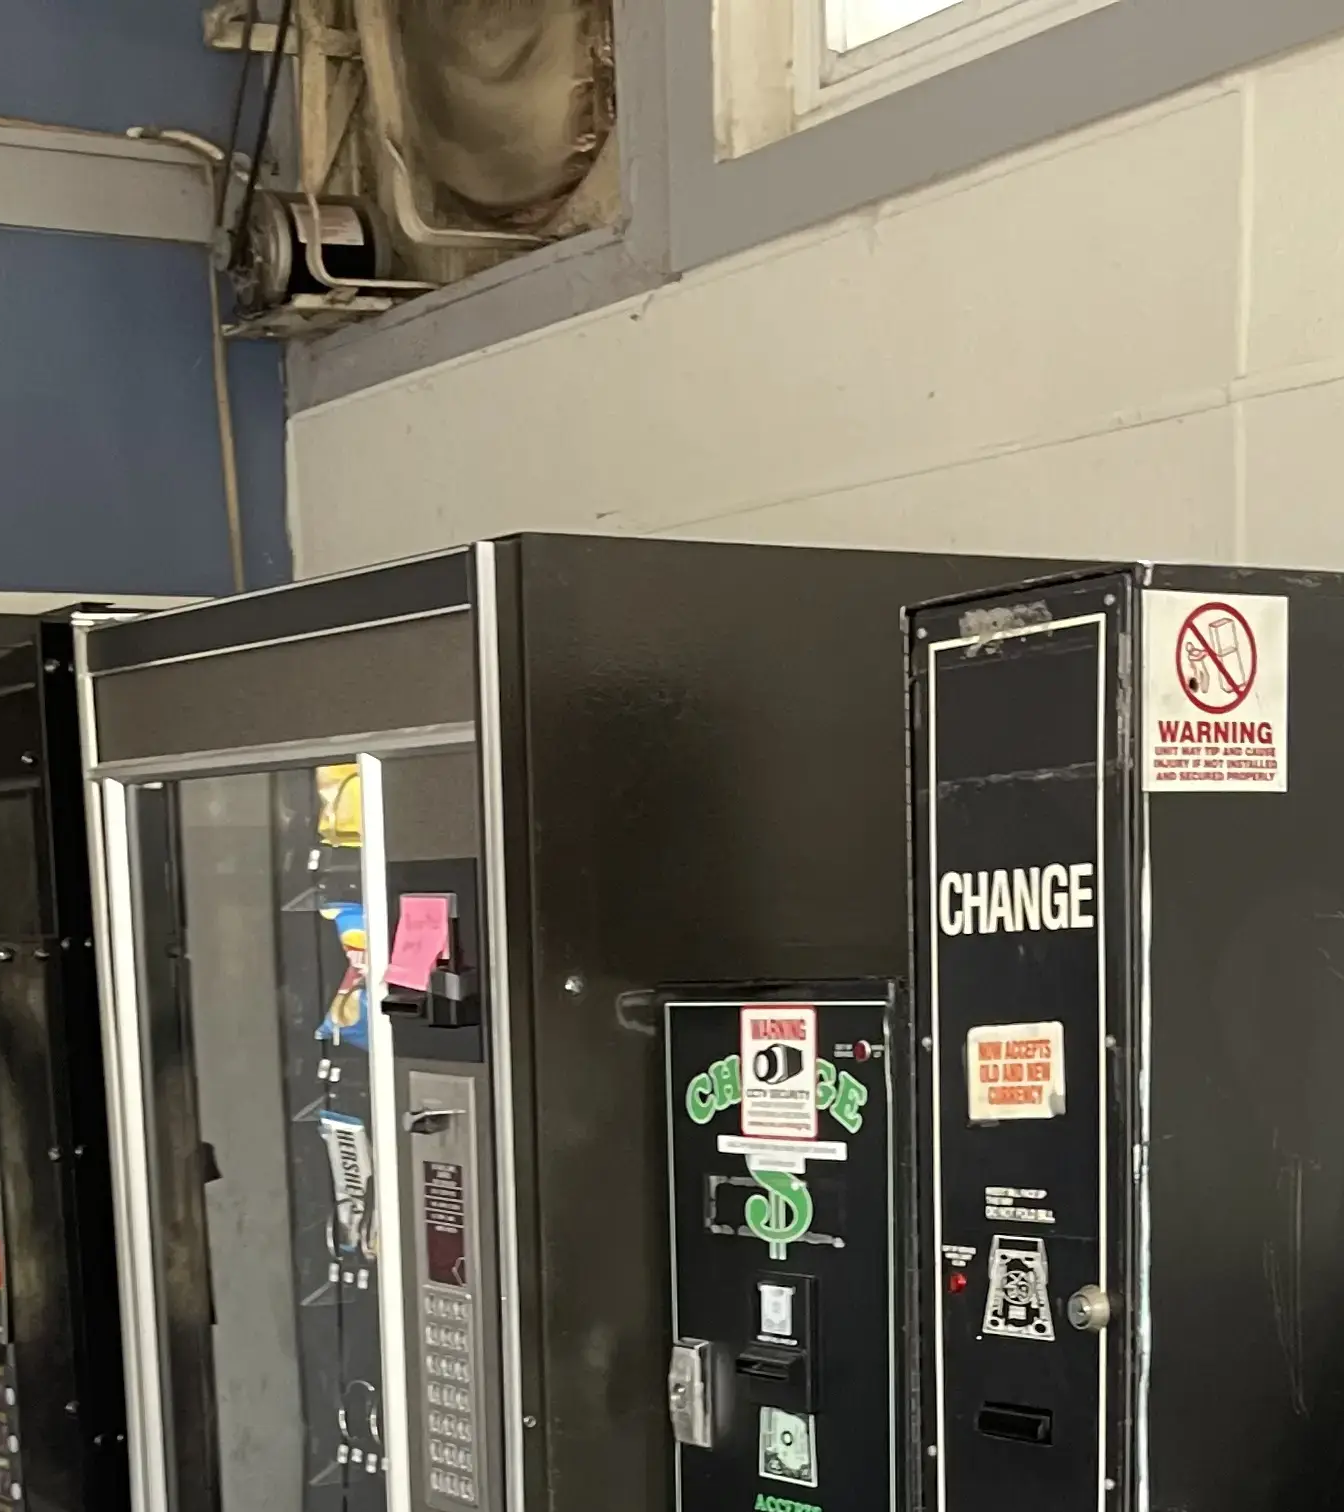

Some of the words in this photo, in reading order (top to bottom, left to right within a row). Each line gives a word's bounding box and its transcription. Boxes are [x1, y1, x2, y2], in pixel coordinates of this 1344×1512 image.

[1158, 720, 1273, 744] WARNING
[1155, 746, 1178, 755] UNIT
[1182, 747, 1202, 755] MAY
[1204, 747, 1220, 755] TIP
[1223, 747, 1242, 756] AND
[1245, 747, 1276, 757] CAUSE
[1153, 759, 1189, 768] INJURY
[1192, 760, 1201, 768] IF
[1204, 760, 1224, 768] NOT
[1227, 760, 1277, 769] INSTALLED
[1156, 771, 1177, 780] AND
[1180, 771, 1224, 781] SECURED
[1227, 772, 1275, 781] PROPERLY
[939, 862, 1094, 936] CHANGE
[750, 1019, 806, 1040] WARNING
[979, 1041, 1002, 1060] NOW
[1005, 1039, 1051, 1059] ACCEPTS
[980, 1063, 999, 1083] OLD
[1003, 1063, 1023, 1082] AND
[1026, 1062, 1050, 1081] NEW
[686, 1054, 868, 1134] CHGE
[988, 1085, 1043, 1104] CURRENCY
